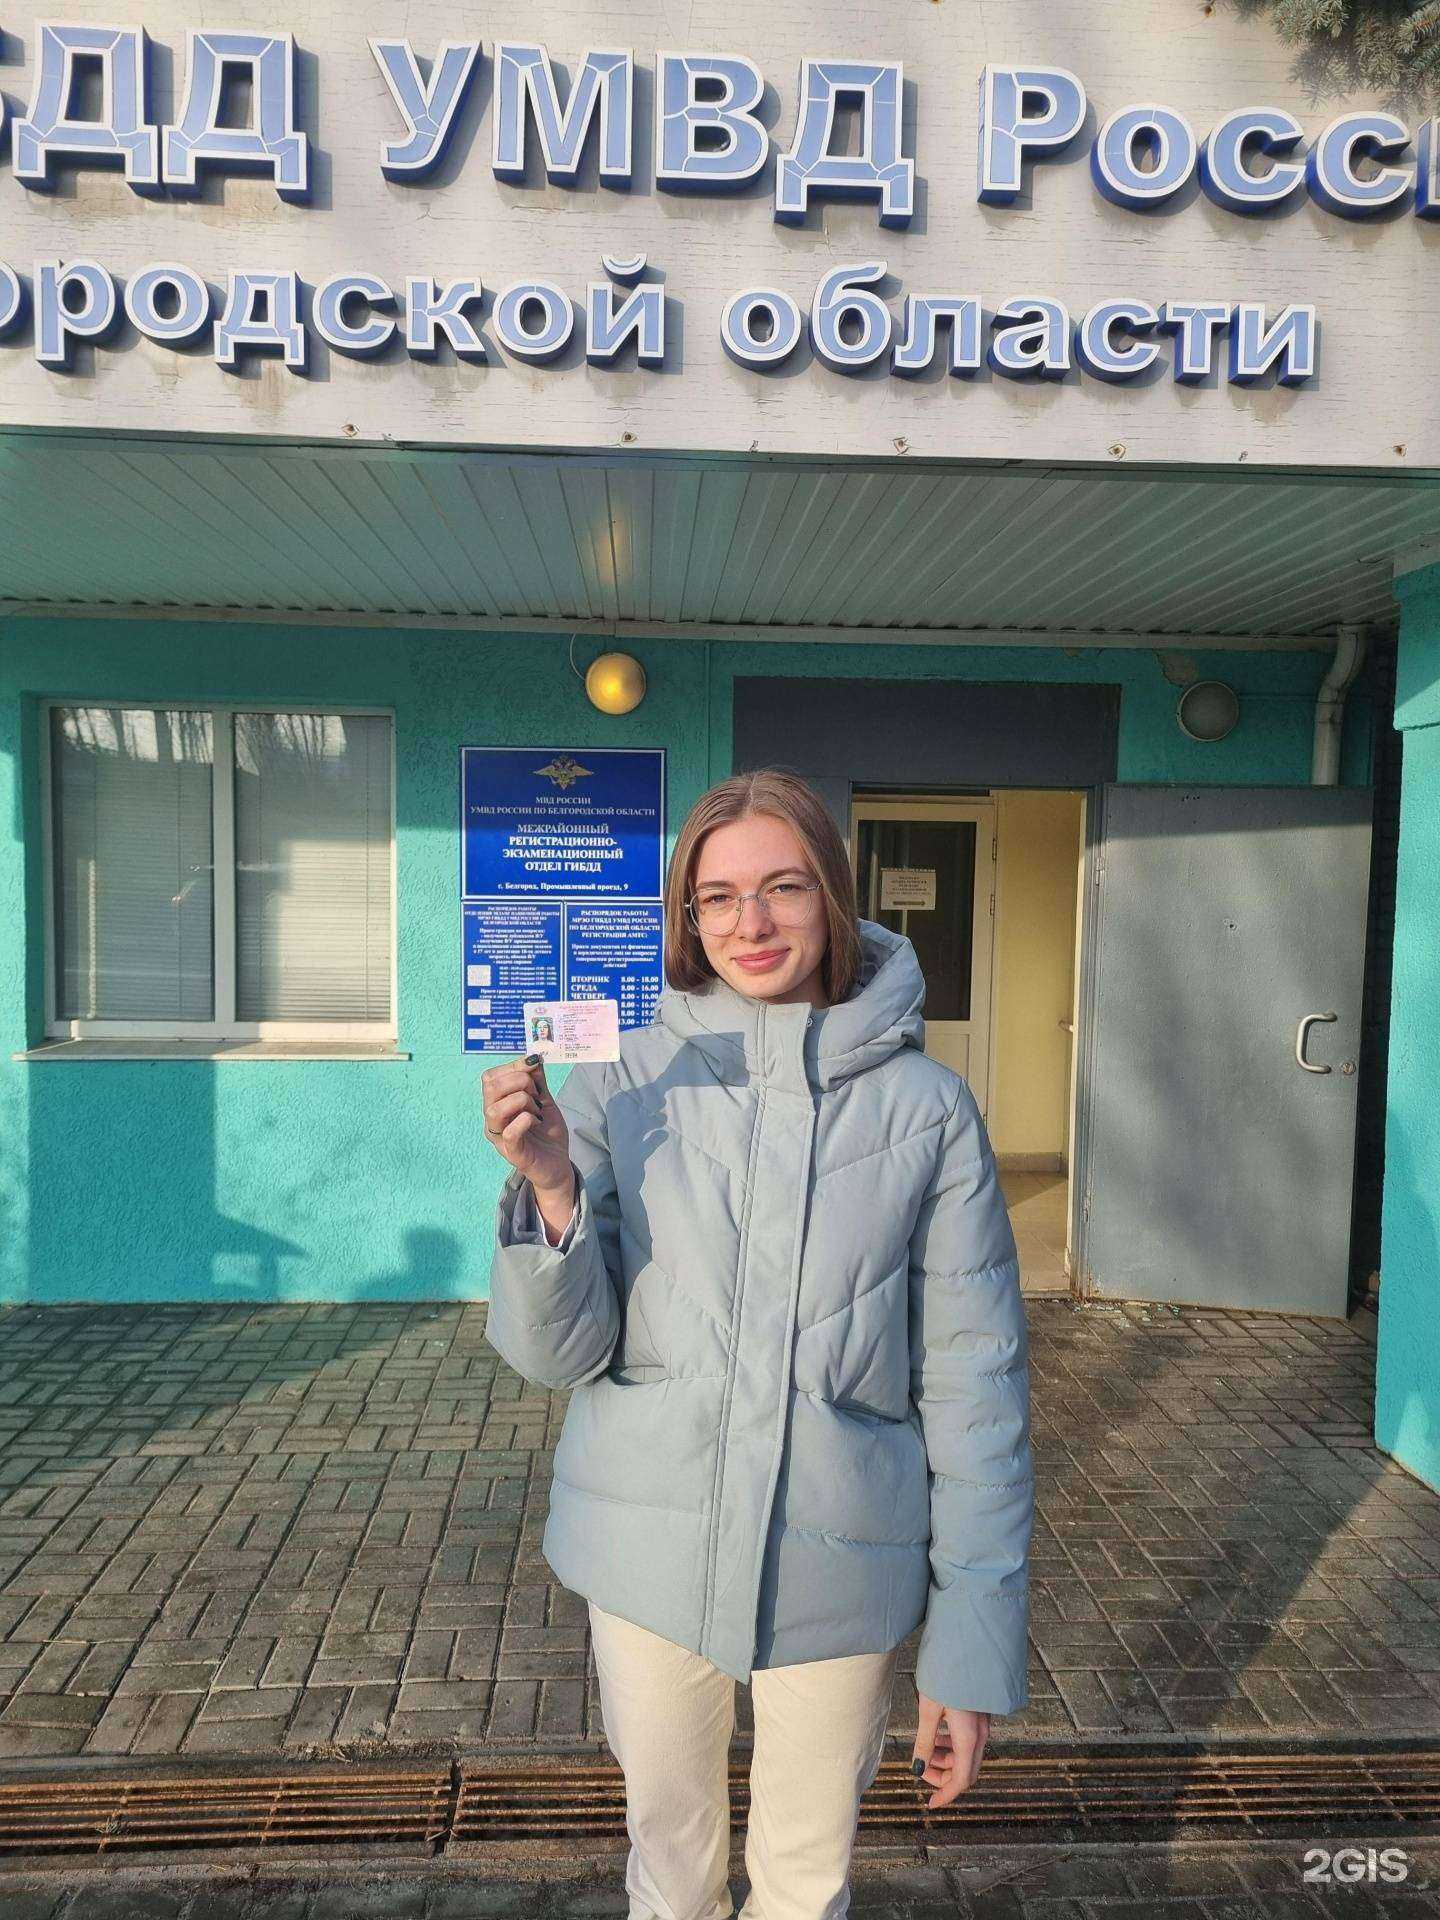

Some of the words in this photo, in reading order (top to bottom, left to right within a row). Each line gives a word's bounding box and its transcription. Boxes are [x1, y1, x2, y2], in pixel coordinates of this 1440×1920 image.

[0, 20, 309, 201] ДД
[367, 38, 915, 230] УМВД
[0, 253, 665, 373] родской
[720, 261, 1316, 387] области
[470, 807, 495, 815] УМВД
[495, 807, 532, 815] РОССИИ
[534, 807, 546, 815] ПО
[548, 807, 614, 815] БЕЛГОРОДСКОЙ
[616, 807, 655, 815] ОБЛАСТИ
[517, 823, 609, 834] МЕЖРАЙОННЫЙ
[509, 836, 617, 847] РЕГИСТРАЦИОННО-
[502, 848, 623, 859] ЭКЗАМЕНАЦИОННЫЙ
[525, 862, 561, 872] ОТДЕЛ
[564, 862, 602, 872] ГИБДД
